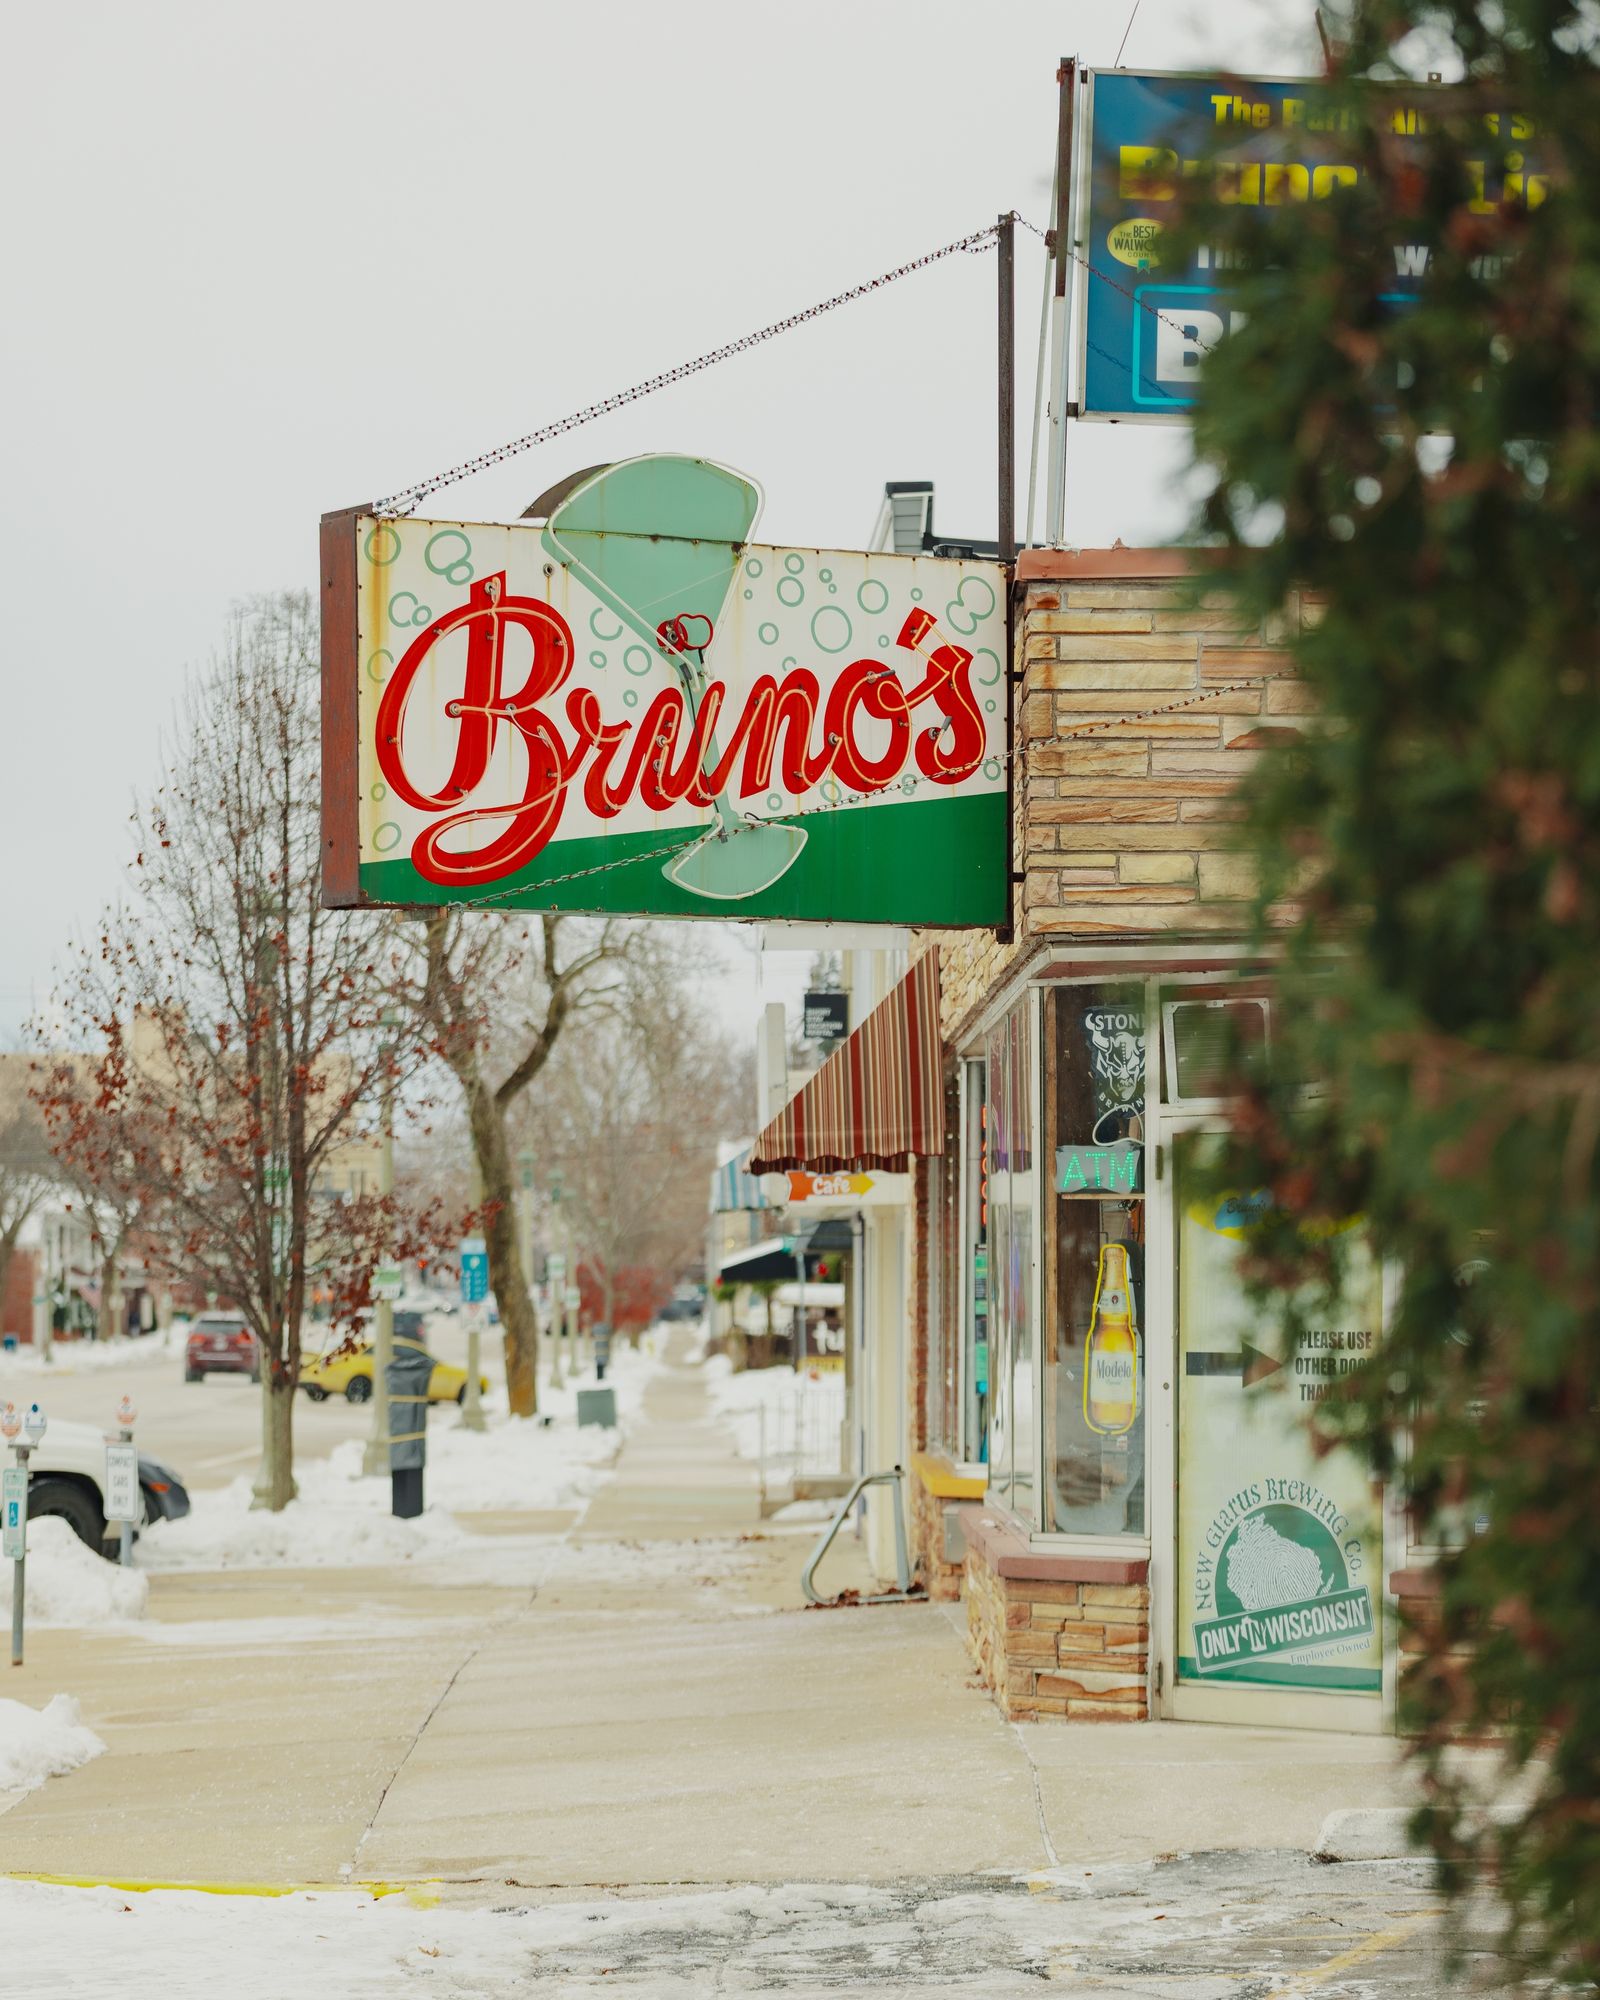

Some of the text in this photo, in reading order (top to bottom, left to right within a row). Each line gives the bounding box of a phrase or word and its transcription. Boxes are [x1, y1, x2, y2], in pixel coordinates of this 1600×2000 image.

[1211, 95, 1270, 129] The
[1133, 225, 1156, 239] BEST
[376, 570, 986, 886] Bruno's
[1095, 1014, 1145, 1031] STON
[1099, 1091, 1145, 1113] BREWIN
[1062, 1151, 1136, 1188] ATM
[812, 1177, 850, 1195] Cafe
[1299, 1331, 1372, 1350] PLEASE USE
[1096, 1359, 1132, 1379] Modelo
[1295, 1357, 1337, 1376] OTHER
[1200, 1623, 1241, 1659] ONLY
[1265, 1596, 1368, 1645] WISCONSIN
[1290, 1637, 1371, 1665] Employee Owned
